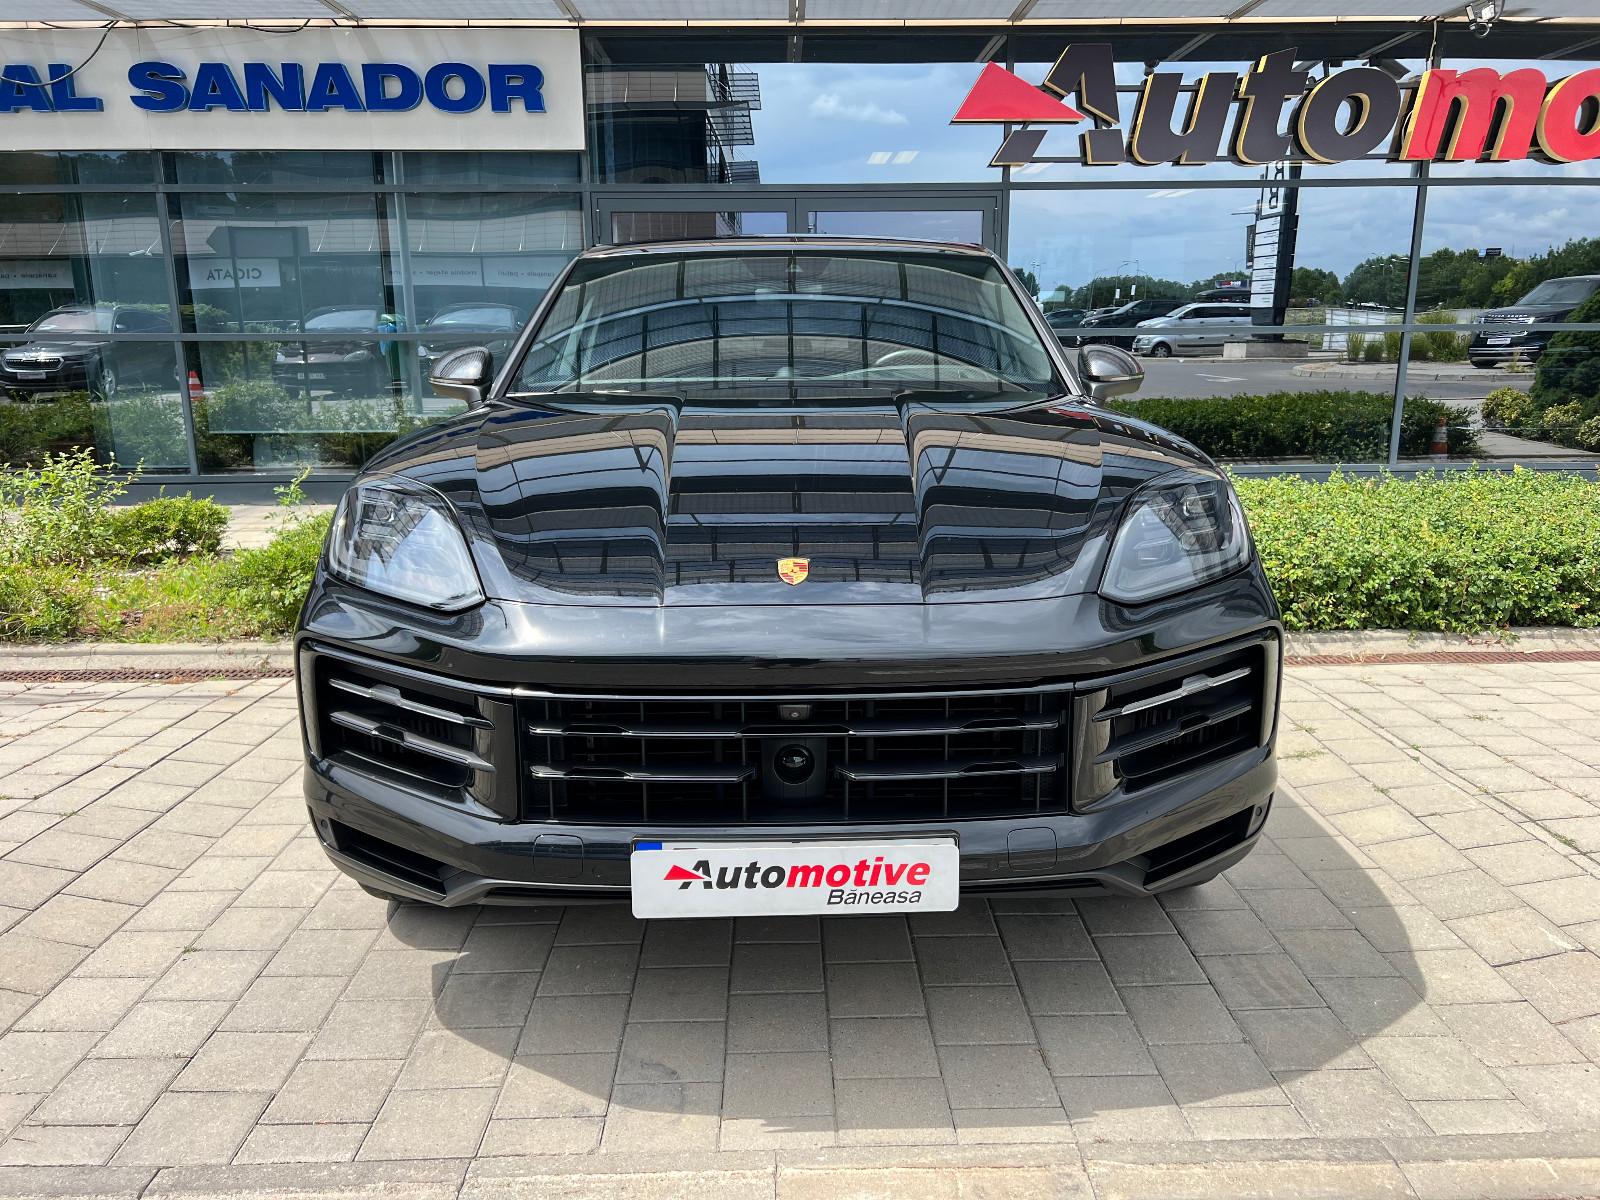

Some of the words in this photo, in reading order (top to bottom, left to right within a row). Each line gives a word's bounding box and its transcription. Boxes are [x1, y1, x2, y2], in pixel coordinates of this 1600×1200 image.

[0, 64, 105, 112] AL
[127, 61, 547, 114] SANADOR
[951, 43, 1600, 166] Automo
[663, 856, 931, 890] Automotive
[827, 888, 922, 905] Băneasa
